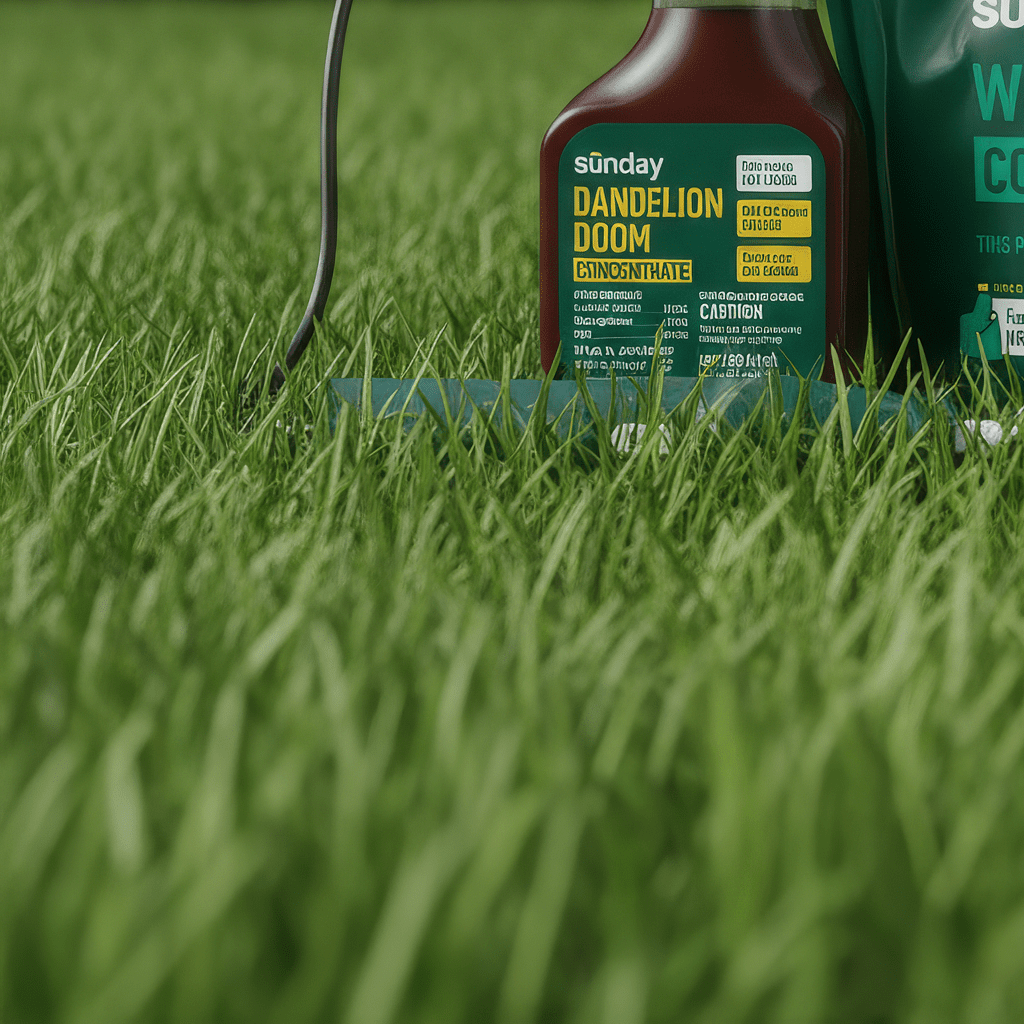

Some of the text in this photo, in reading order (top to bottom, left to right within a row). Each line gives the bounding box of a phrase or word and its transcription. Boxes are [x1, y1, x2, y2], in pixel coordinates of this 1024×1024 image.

[574, 152, 664, 181] sunday
[573, 185, 723, 218] DANDELION
[573, 221, 651, 253] DOOM
